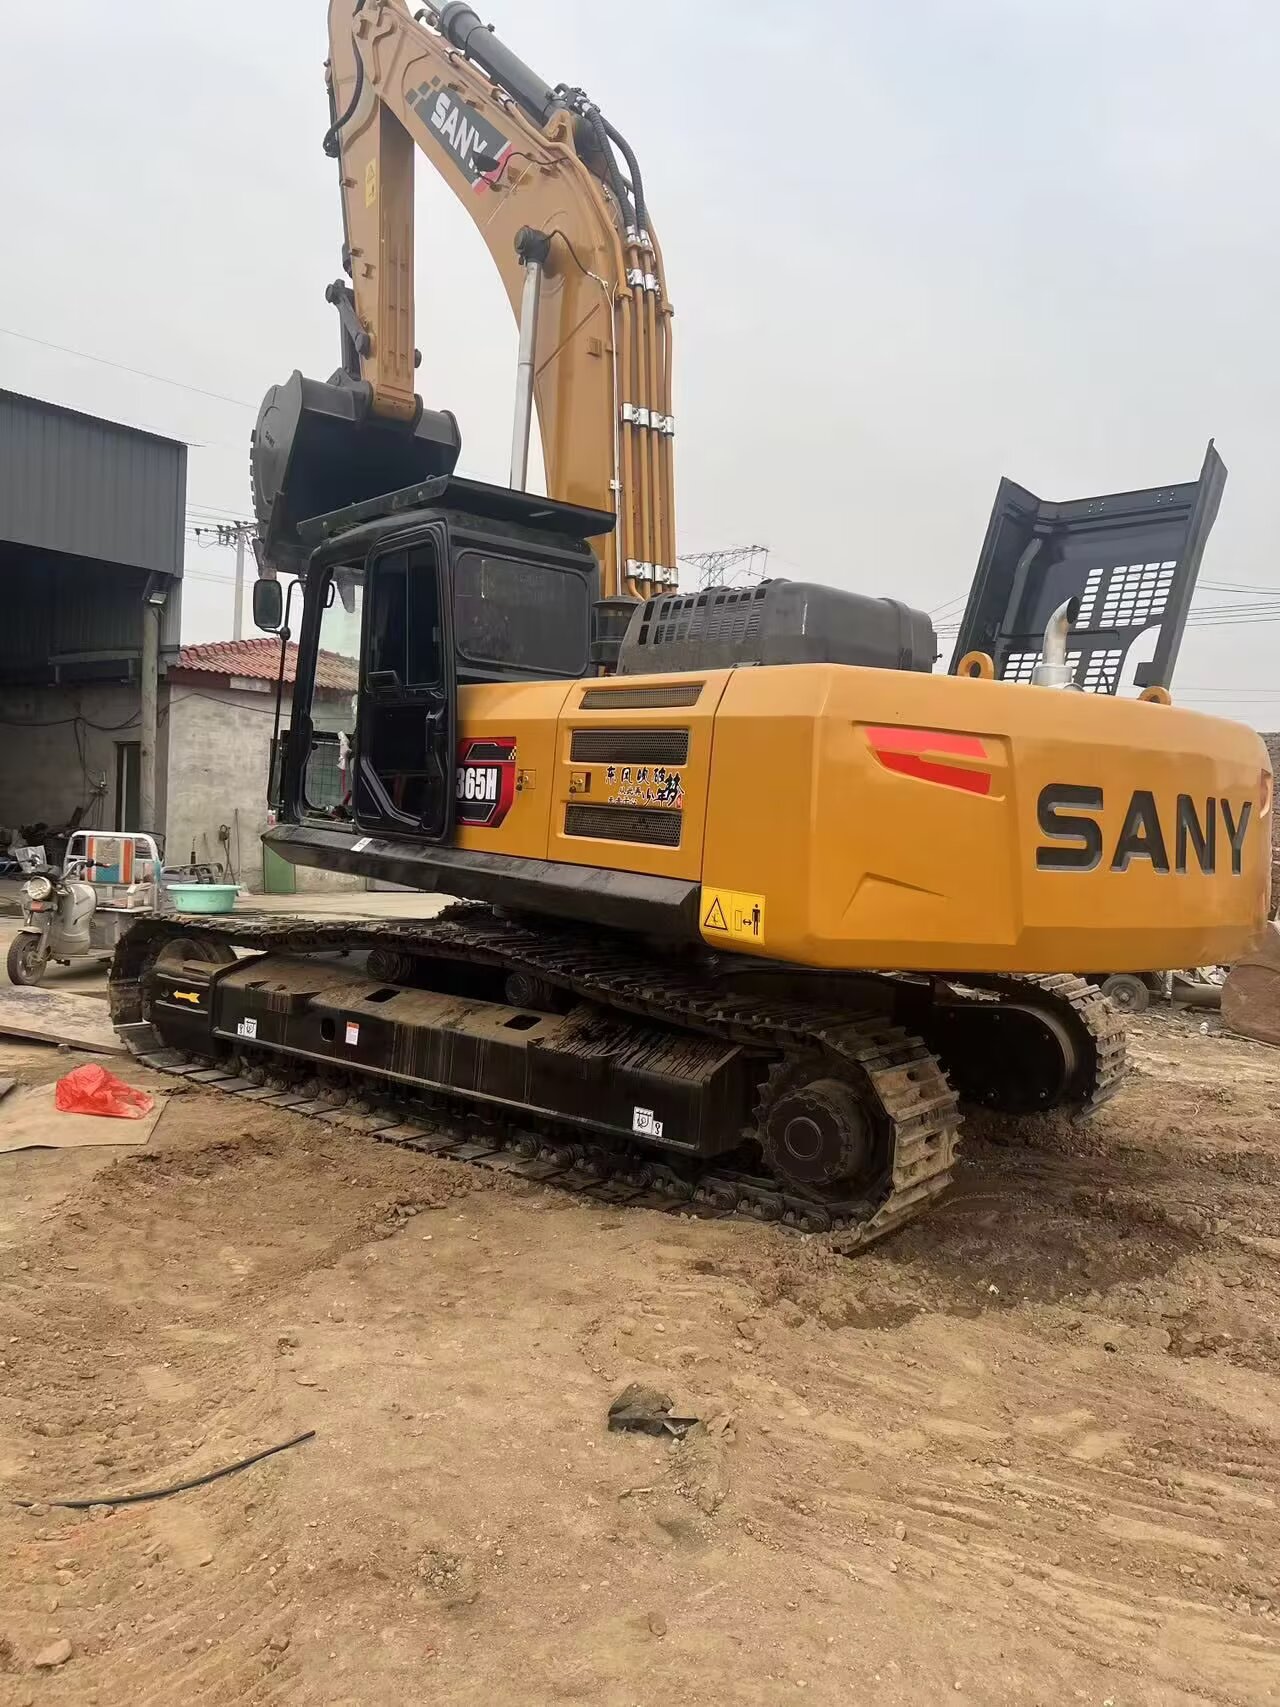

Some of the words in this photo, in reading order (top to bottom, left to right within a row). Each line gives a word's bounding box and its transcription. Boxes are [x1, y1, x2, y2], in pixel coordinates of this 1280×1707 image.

[430, 92, 488, 170] SANY
[455, 767, 498, 800] 365H
[1036, 783, 1253, 877] SANY
